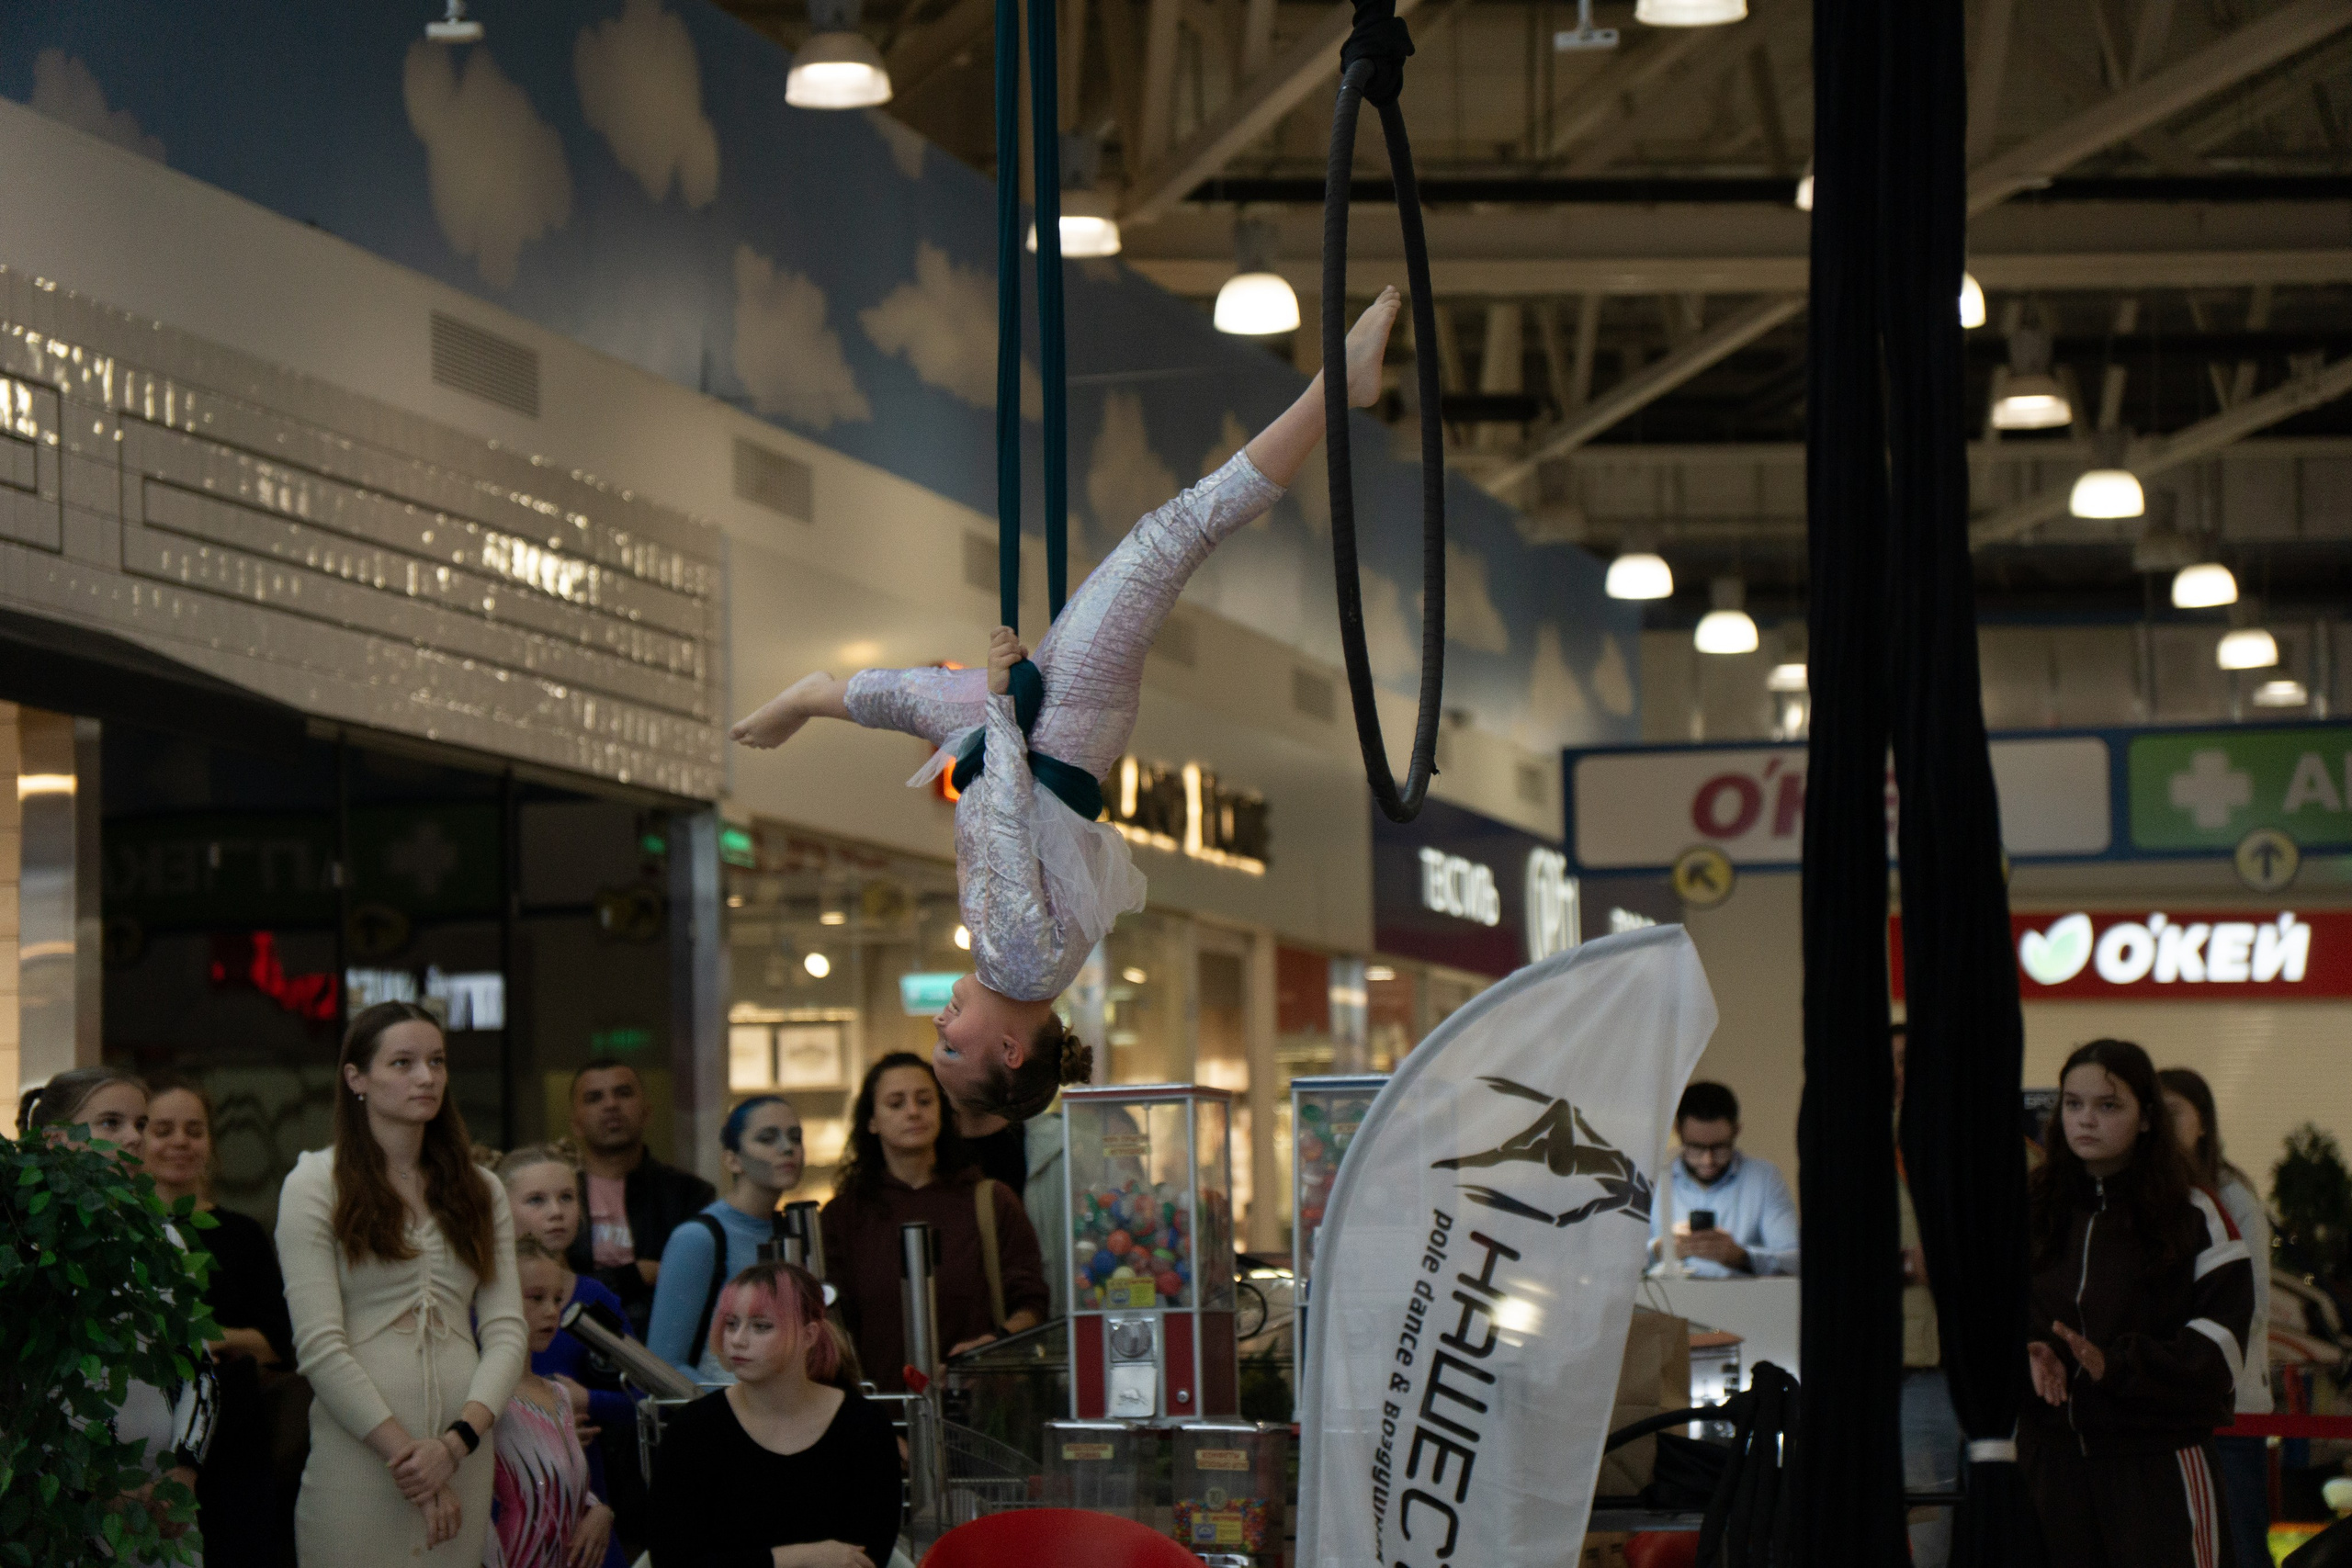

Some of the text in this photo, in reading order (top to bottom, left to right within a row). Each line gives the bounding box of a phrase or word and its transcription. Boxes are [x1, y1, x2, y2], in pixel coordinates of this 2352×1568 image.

[2281, 750, 2352, 812] А
[1421, 1209, 1453, 1274] pole
[1395, 1280, 1436, 1367] dance
[1388, 1372, 1411, 1394] &
[1395, 1230, 1521, 1568] НАШЕС
